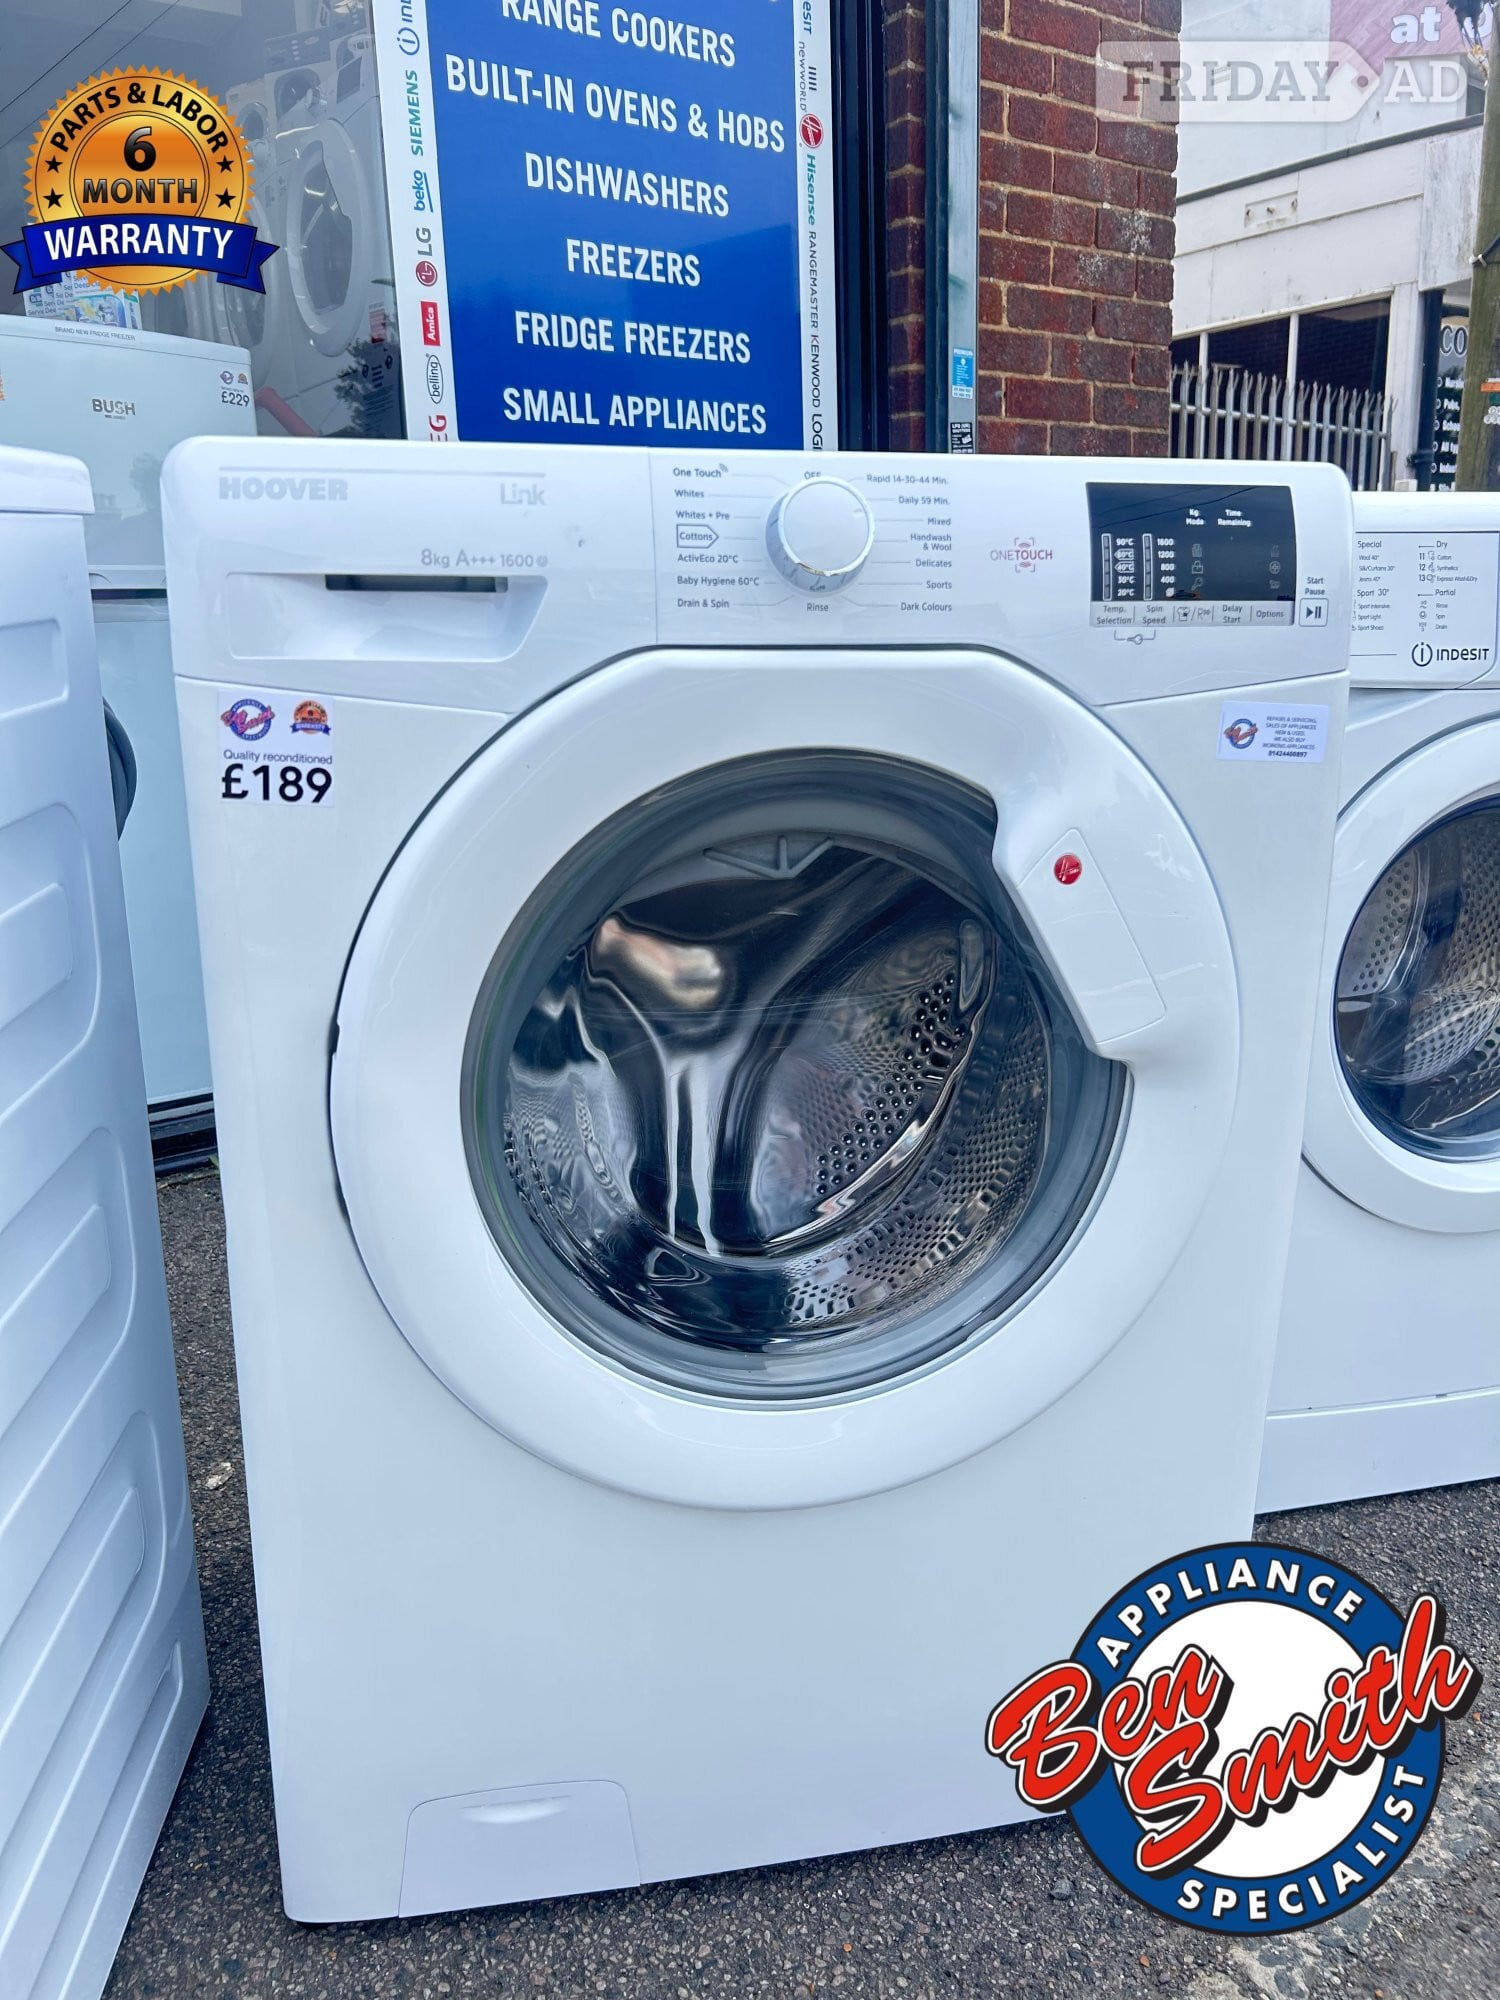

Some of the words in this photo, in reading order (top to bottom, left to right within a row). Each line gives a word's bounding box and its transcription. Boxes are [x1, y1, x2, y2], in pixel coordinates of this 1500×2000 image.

[1391, 6, 1441, 43] at
[611, 7, 735, 68] COOKERS
[445, 53, 574, 114] BUILT-IN
[585, 83, 677, 133] OVENS
[688, 104, 708, 139] &
[718, 108, 785, 153] HOBS
[405, 69, 424, 157] SIEMENS
[525, 151, 730, 218] DISHWASHERS
[807, 153, 815, 226] Hisense
[414, 169, 426, 212] beko
[415, 226, 433, 257] LG
[566, 238, 701, 288] FREEZERS
[809, 231, 818, 328] RANGEMASTER
[427, 307, 436, 341] Amica
[515, 310, 615, 353] FRIDGE
[624, 321, 751, 364] FREEZERS
[811, 335, 820, 408] KENWOOD
[221, 391, 250, 407] £229
[92, 399, 136, 416] BUSH
[503, 387, 600, 426] SMALL
[609, 394, 767, 435] APPLIANCES
[812, 414, 823, 449] LOGI
[673, 467, 692, 477] One
[695, 468, 722, 478] Touch
[867, 475, 890, 484] Rapid
[893, 476, 929, 484] 14-30-44
[933, 475, 948, 485] Min.
[219, 477, 348, 501] HOOVER
[674, 489, 704, 498] Whites
[500, 483, 547, 506] Link
[899, 496, 919, 506] Daily
[921, 497, 931, 505] 59
[934, 497, 950, 506] Min.
[676, 510, 706, 520] Whites
[716, 511, 730, 520] Pre
[1225, 509, 1242, 517] Time
[928, 518, 951, 526] Mixed
[1186, 518, 1205, 527] Mode
[1218, 518, 1251, 527] Remaining
[679, 531, 713, 542] Cottons
[910, 533, 951, 542] Handwash
[923, 543, 929, 551] &
[931, 543, 952, 551] Wool
[1357, 541, 1381, 550] Special
[1436, 541, 1447, 549] Dry
[421, 549, 450, 568] 8kg
[455, 550, 496, 567] A+++
[500, 554, 534, 567] 1600
[678, 554, 715, 563] ActivEco
[717, 554, 739, 564] 20°C
[1419, 552, 1425, 560] 11
[916, 558, 952, 568] Delicates
[677, 576, 699, 588] Baby
[701, 576, 736, 588] Hygiene
[738, 576, 759, 587] 60°C
[926, 580, 952, 590] Sports
[1307, 577, 1324, 585] Start
[1305, 588, 1325, 596] Pause
[1357, 589, 1375, 598] Sport
[677, 598, 699, 608] Drain
[702, 599, 708, 608] &
[710, 599, 730, 611] Spin
[807, 603, 828, 612] Rinse
[901, 602, 920, 611] Dark
[923, 602, 952, 612] Colours
[1146, 605, 1163, 615] Spin
[1222, 605, 1242, 615] Delay
[1256, 609, 1284, 619] Options
[1097, 616, 1131, 625] Selection
[1142, 616, 1166, 626] Speed
[1223, 615, 1241, 624] Start
[223, 749, 260, 763] Quality
[263, 752, 333, 765] reconditioned
[222, 763, 332, 803] £189
